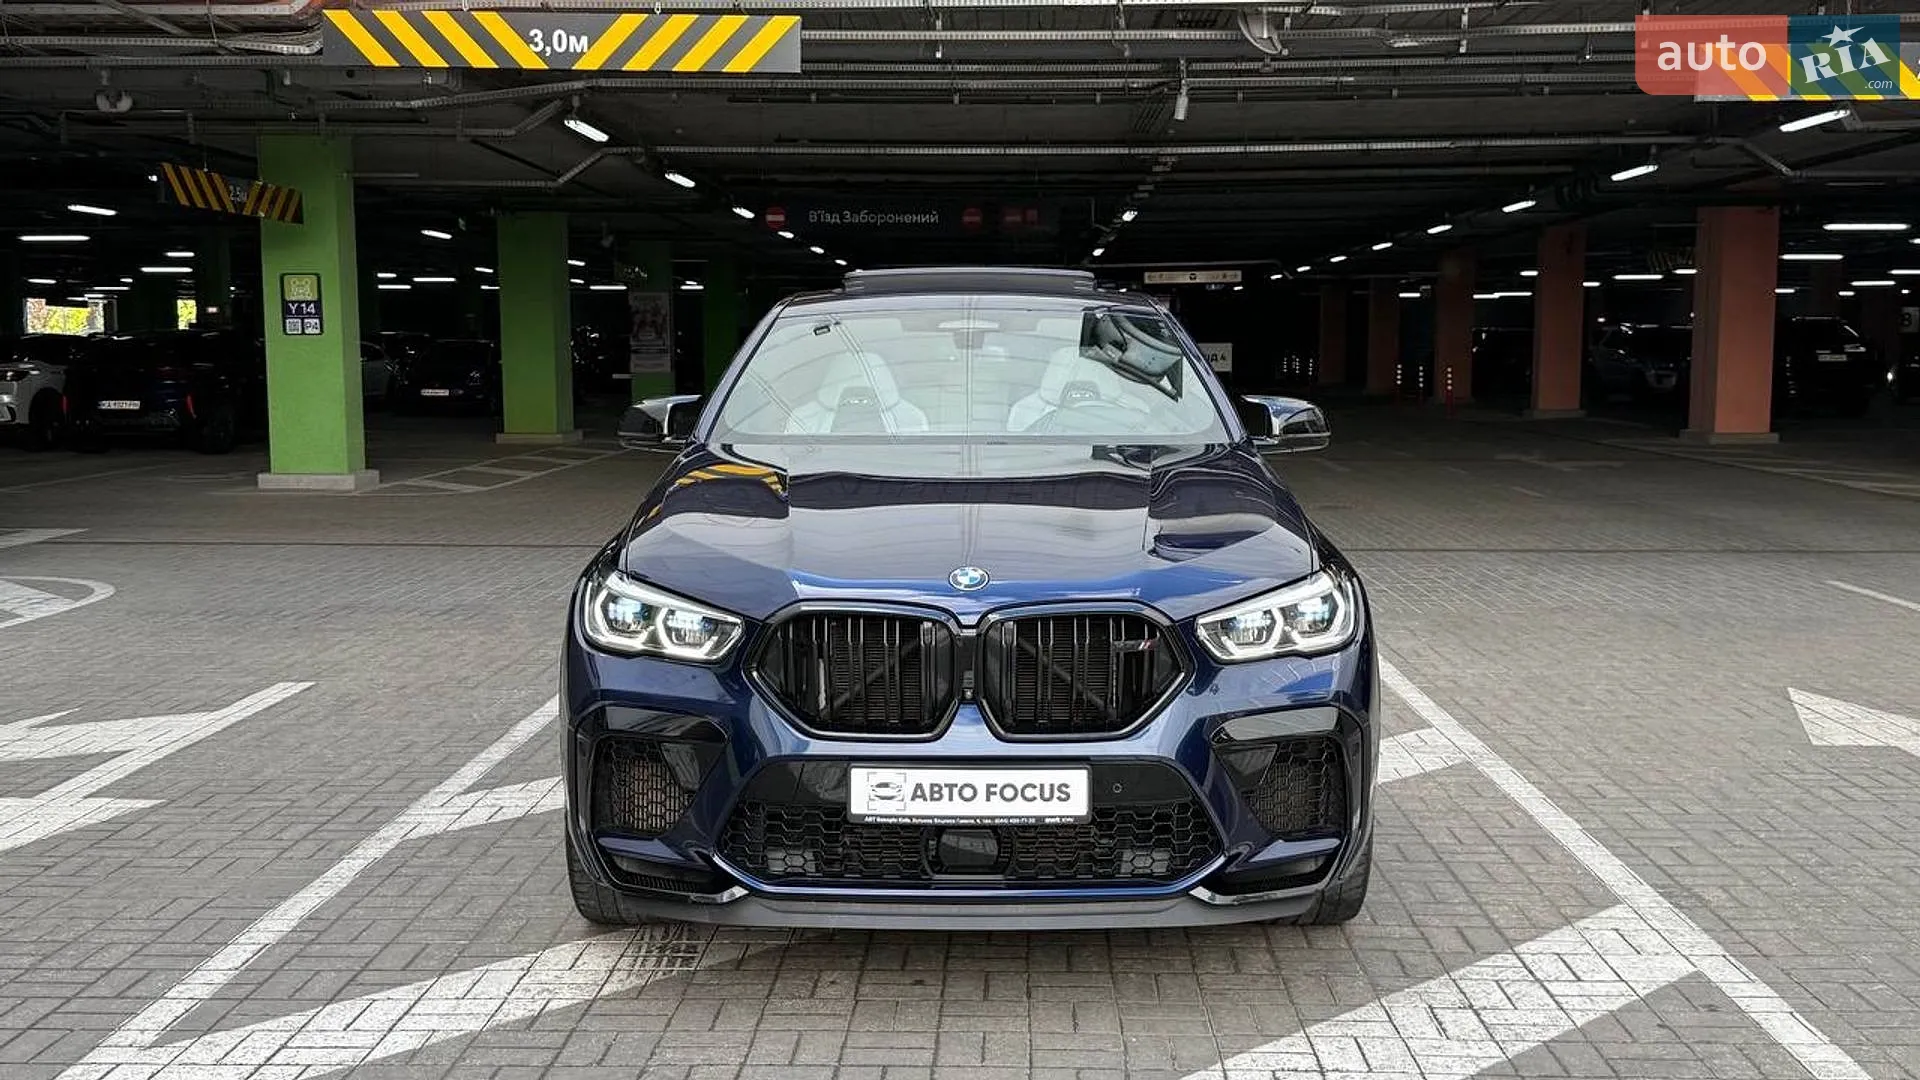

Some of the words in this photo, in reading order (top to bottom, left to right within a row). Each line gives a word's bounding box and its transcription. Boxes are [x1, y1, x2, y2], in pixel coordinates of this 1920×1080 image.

[529, 29, 588, 56] 3,0м
[843, 209, 939, 226] Заборонений
[984, 782, 1071, 802] FOCUS
